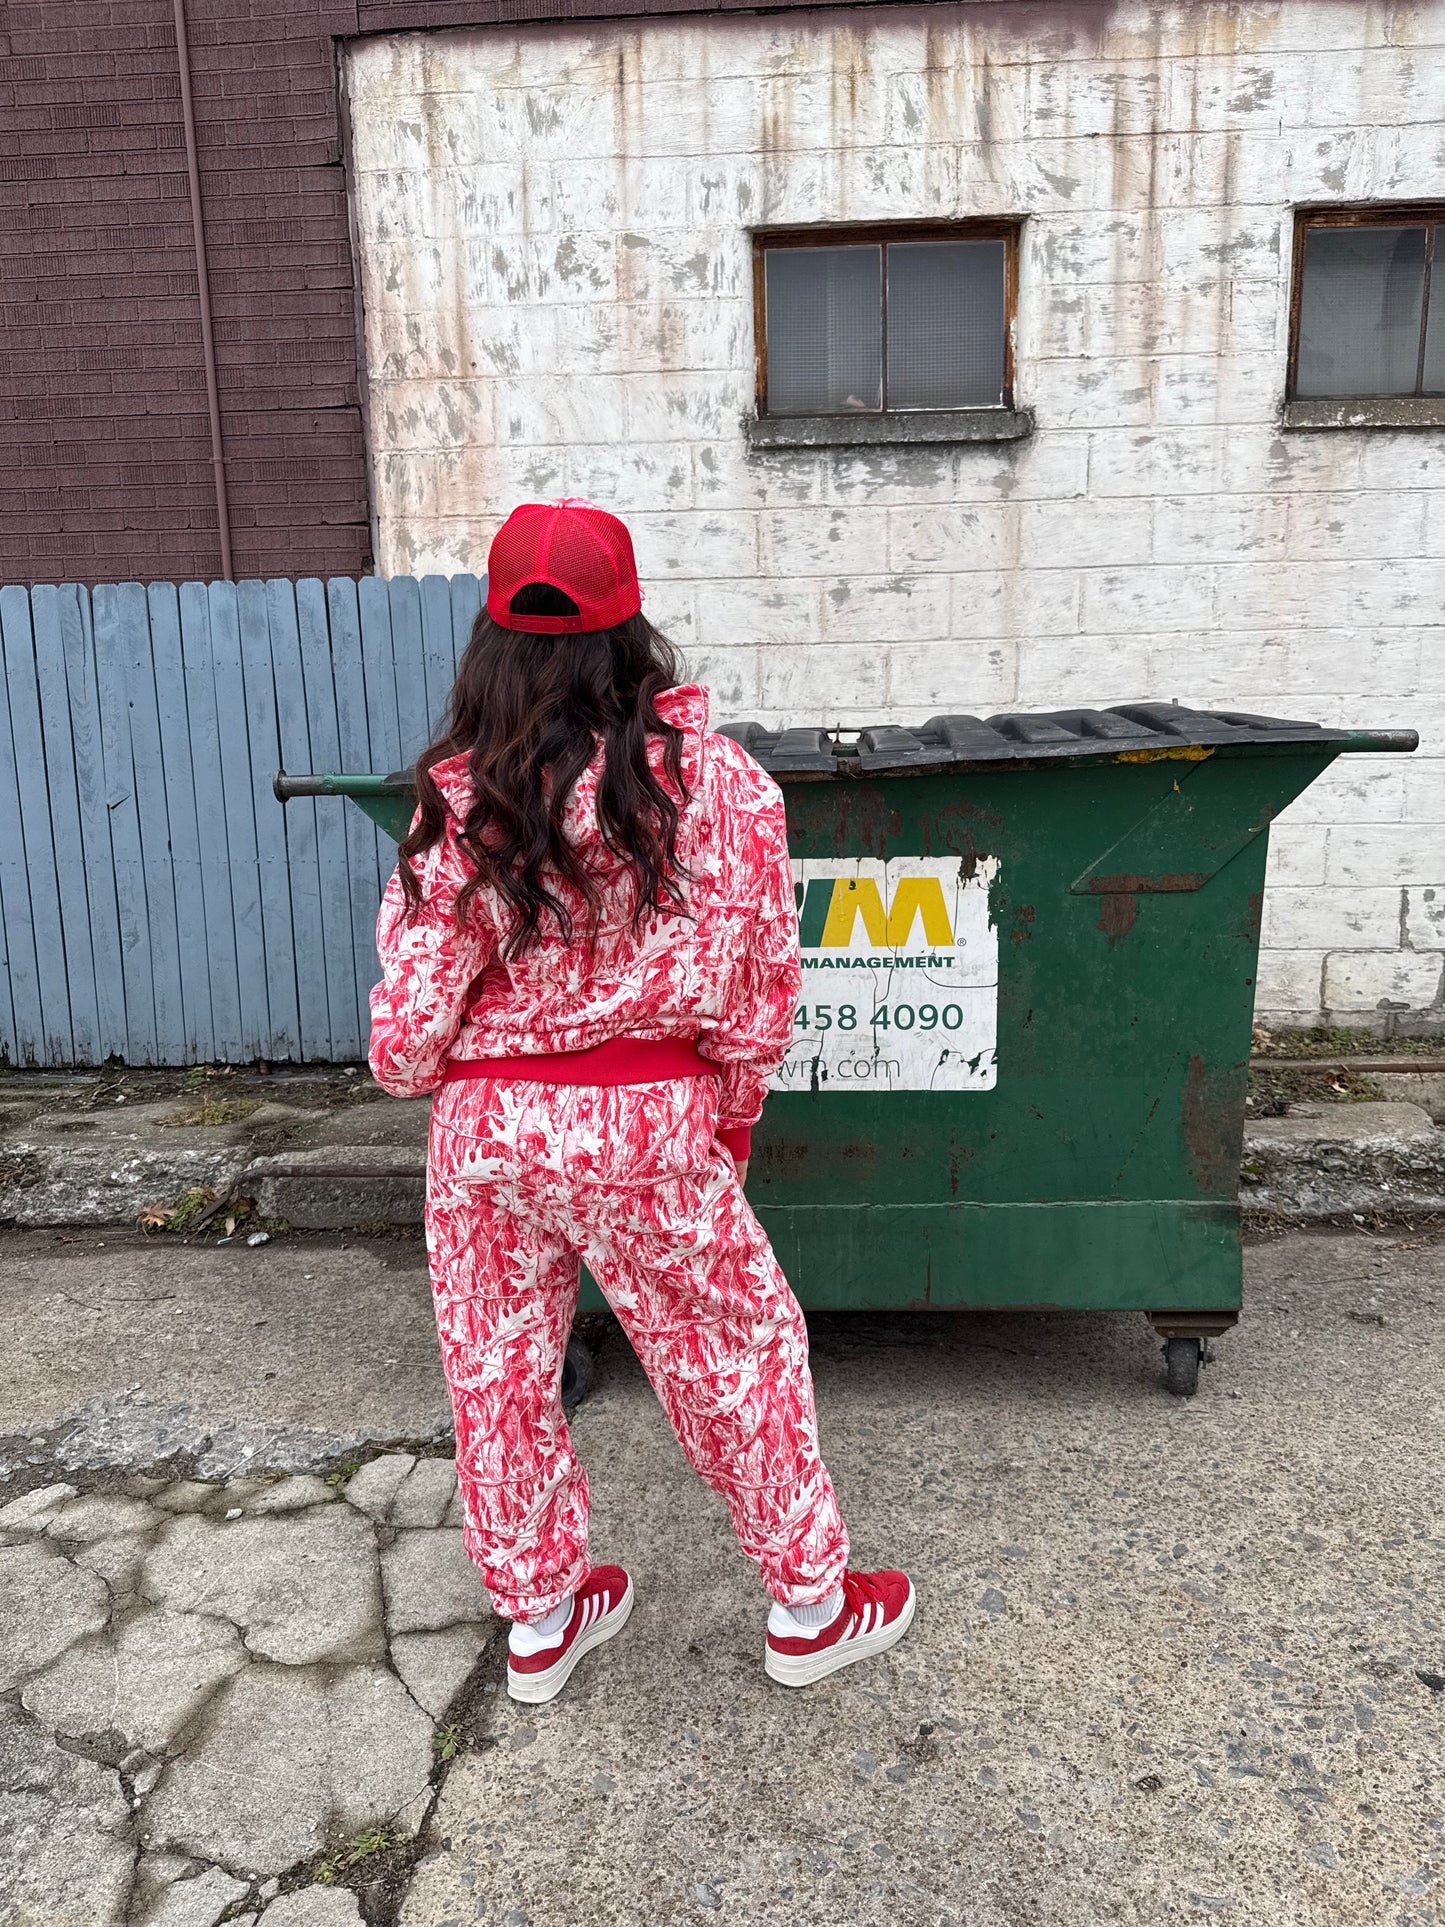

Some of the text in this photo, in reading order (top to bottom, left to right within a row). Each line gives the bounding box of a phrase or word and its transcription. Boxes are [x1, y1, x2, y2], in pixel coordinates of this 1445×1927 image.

[800, 956, 956, 969] MANAGEMENT
[794, 1003, 964, 1031] 458 4090
